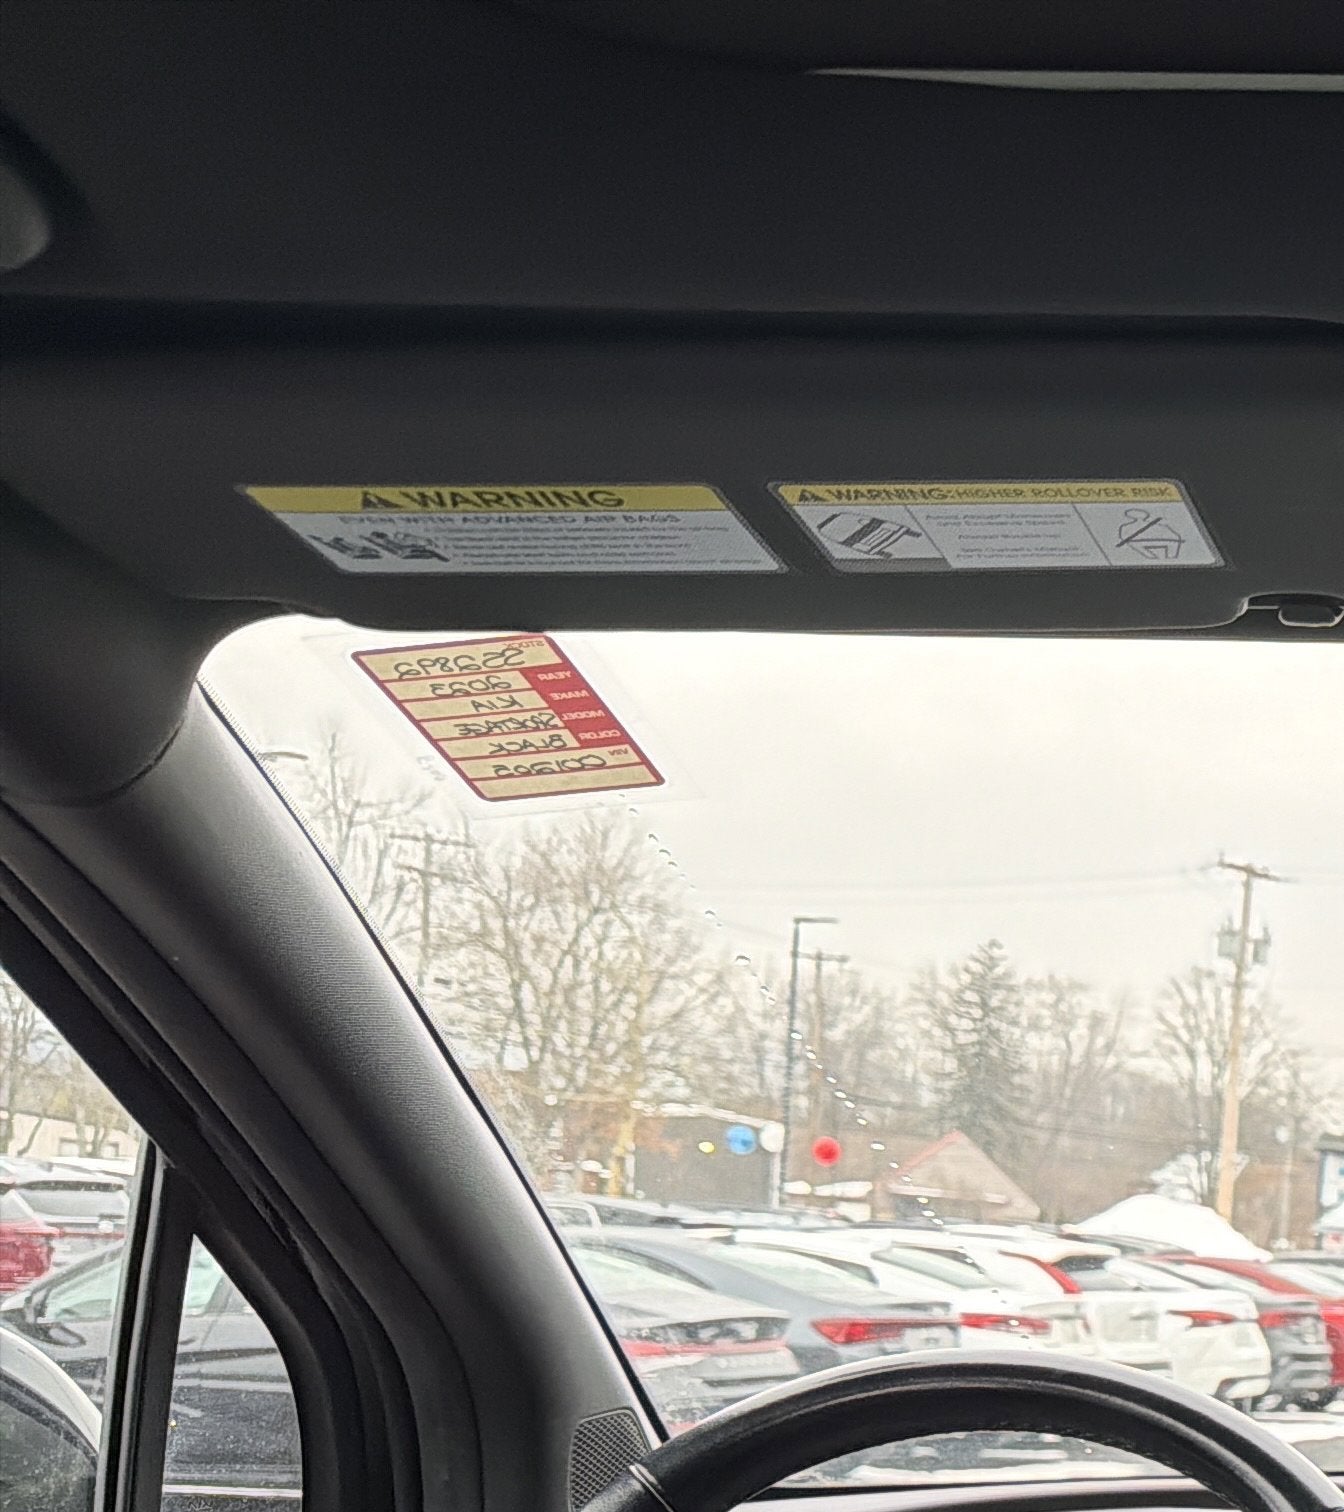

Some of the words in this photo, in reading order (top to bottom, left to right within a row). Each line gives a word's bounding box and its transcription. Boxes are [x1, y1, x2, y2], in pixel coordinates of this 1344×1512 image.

[955, 486, 1027, 498] HIGHER
[1031, 486, 1125, 498] ROLLOVER
[1131, 486, 1172, 498] RISK
[399, 489, 625, 509] WARNING
[461, 514, 577, 524] ADVANCED
[622, 513, 681, 524] BAGS
